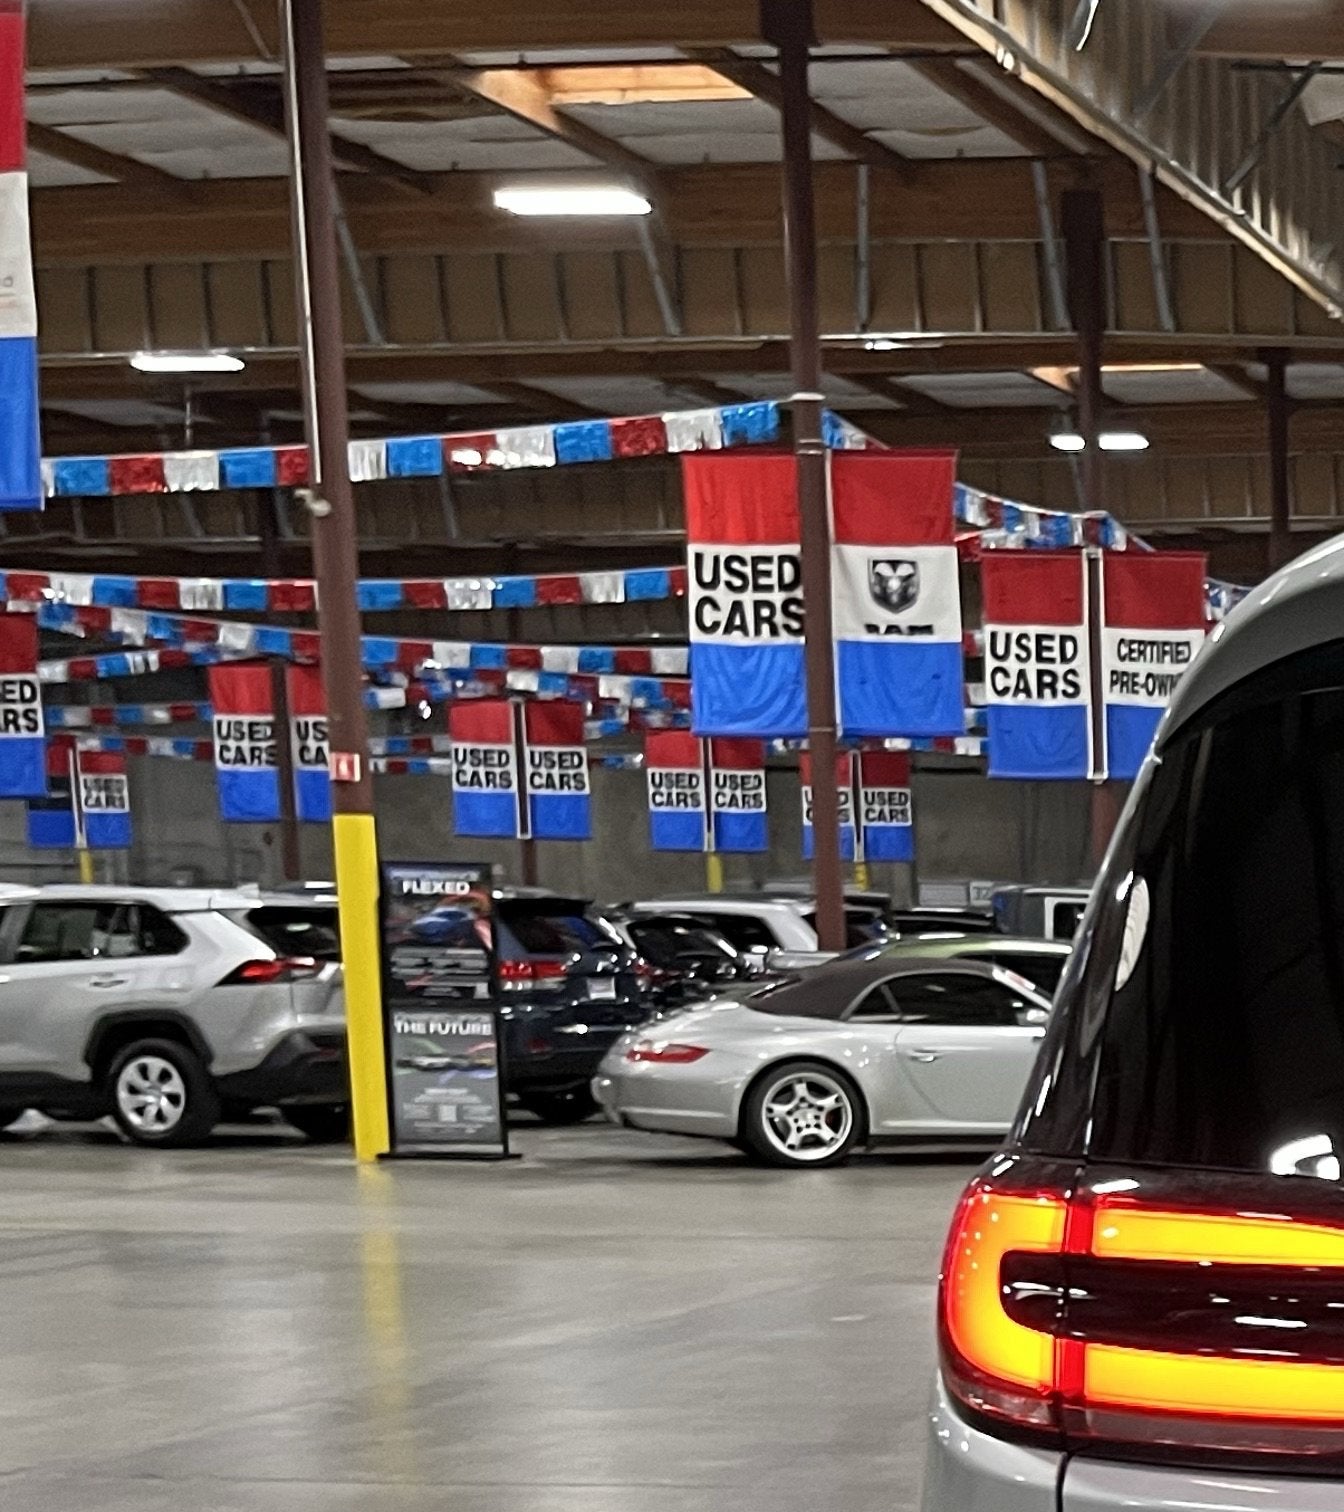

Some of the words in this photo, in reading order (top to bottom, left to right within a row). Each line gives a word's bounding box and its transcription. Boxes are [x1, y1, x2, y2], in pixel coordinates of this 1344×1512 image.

[694, 552, 801, 594] USED
[694, 596, 806, 638] CARS
[989, 631, 1079, 664] USED
[1117, 637, 1191, 664] CERTIFIED
[0, 680, 37, 704] ED
[990, 666, 1081, 699] CARS
[0, 708, 38, 733] RS
[296, 720, 328, 742] US
[299, 744, 328, 766] CA
[454, 748, 510, 768] USED
[529, 750, 583, 770] USED
[455, 769, 512, 789] CARS
[529, 771, 586, 791] CARS
[650, 772, 700, 789] USED
[714, 773, 762, 790] USED
[651, 790, 701, 808] CARS
[714, 791, 763, 809] CARS
[864, 790, 909, 806] USED
[864, 807, 910, 823] CARS
[402, 879, 470, 895] FLEXED
[396, 1020, 427, 1034] THE
[429, 1021, 493, 1036] FUTURE
